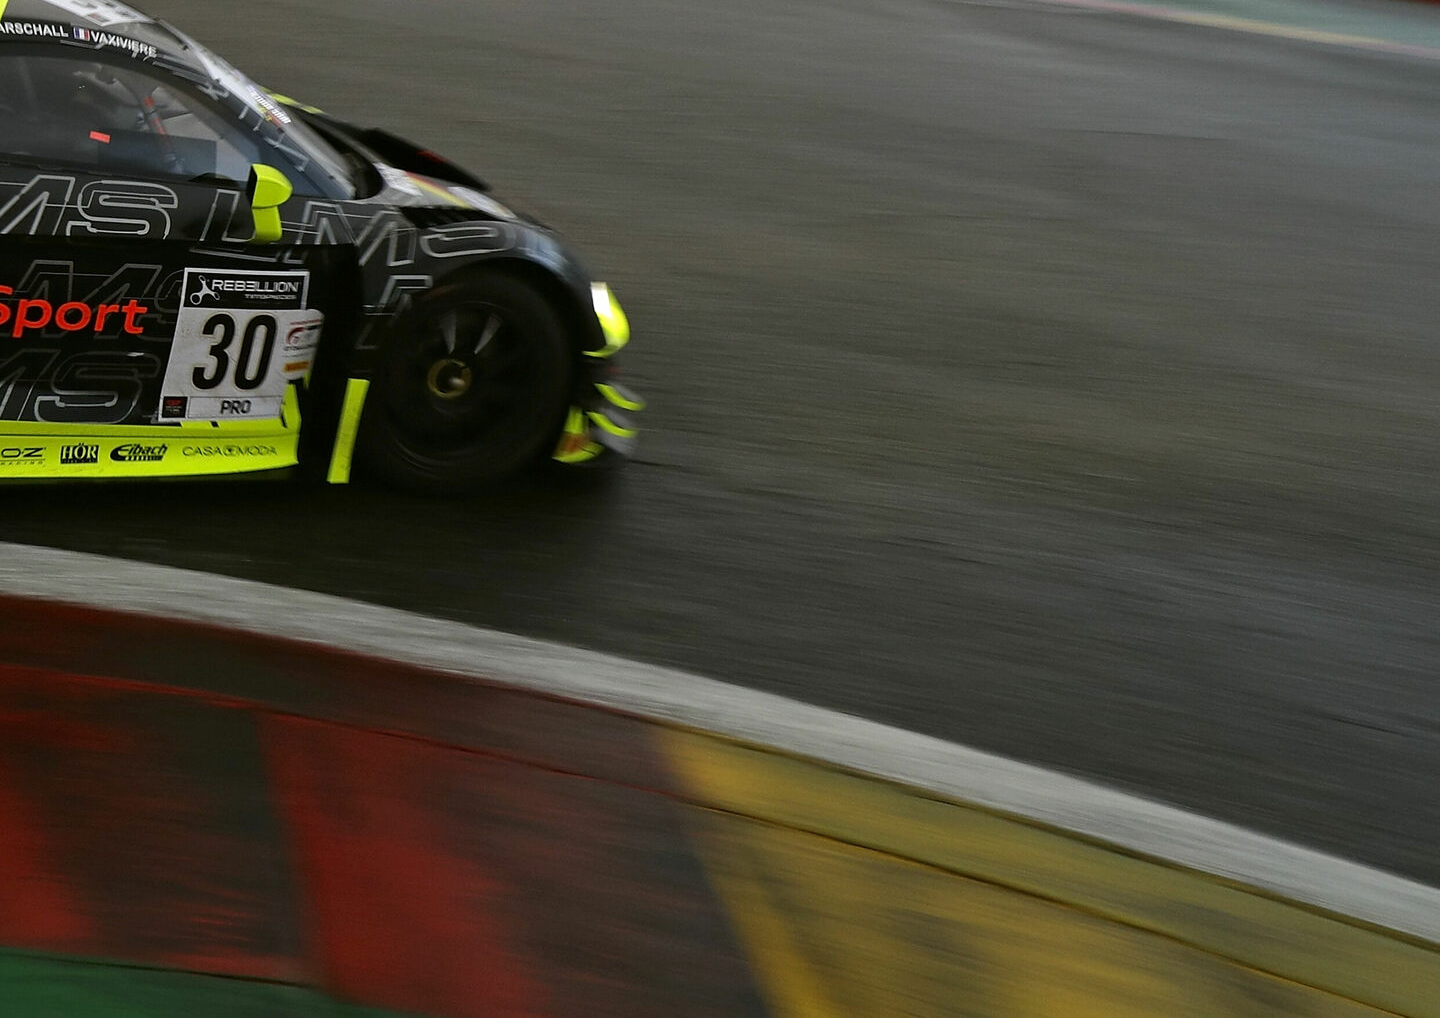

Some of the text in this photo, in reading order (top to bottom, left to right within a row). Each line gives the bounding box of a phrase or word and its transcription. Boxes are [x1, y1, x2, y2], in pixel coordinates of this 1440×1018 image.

[90, 30, 158, 59] VAXIVIERE
[211, 279, 299, 293] REBELLION
[192, 313, 277, 390] 30
[220, 399, 252, 415] PRO
[62, 442, 98, 460] HÖR
[110, 443, 168, 462] Eibach
